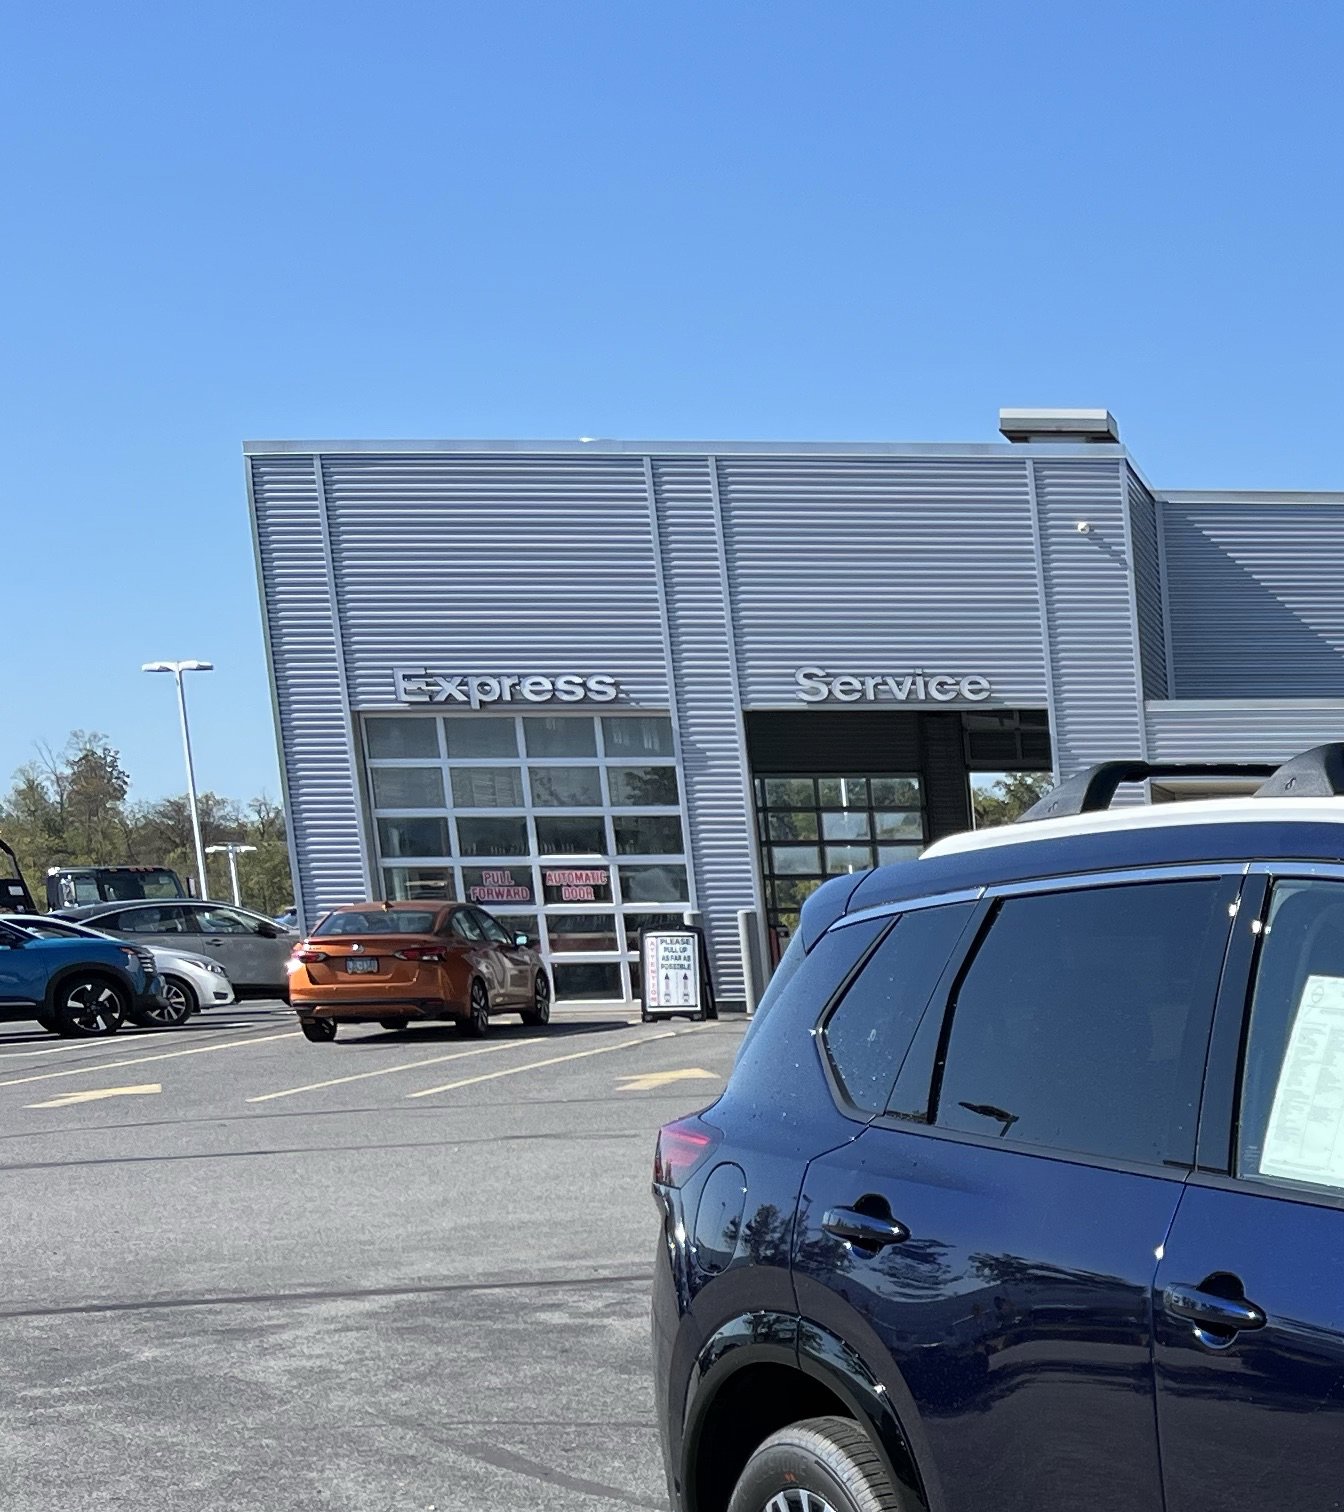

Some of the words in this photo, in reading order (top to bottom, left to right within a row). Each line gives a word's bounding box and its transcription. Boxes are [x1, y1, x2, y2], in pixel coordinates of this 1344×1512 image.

[392, 667, 619, 710] Express
[794, 665, 992, 704] Service
[482, 870, 515, 886] PULL
[546, 870, 608, 886] AUTOMATIC
[470, 886, 530, 901] FORWARD
[562, 886, 596, 901] DOOR
[660, 938, 691, 946] PLEASE
